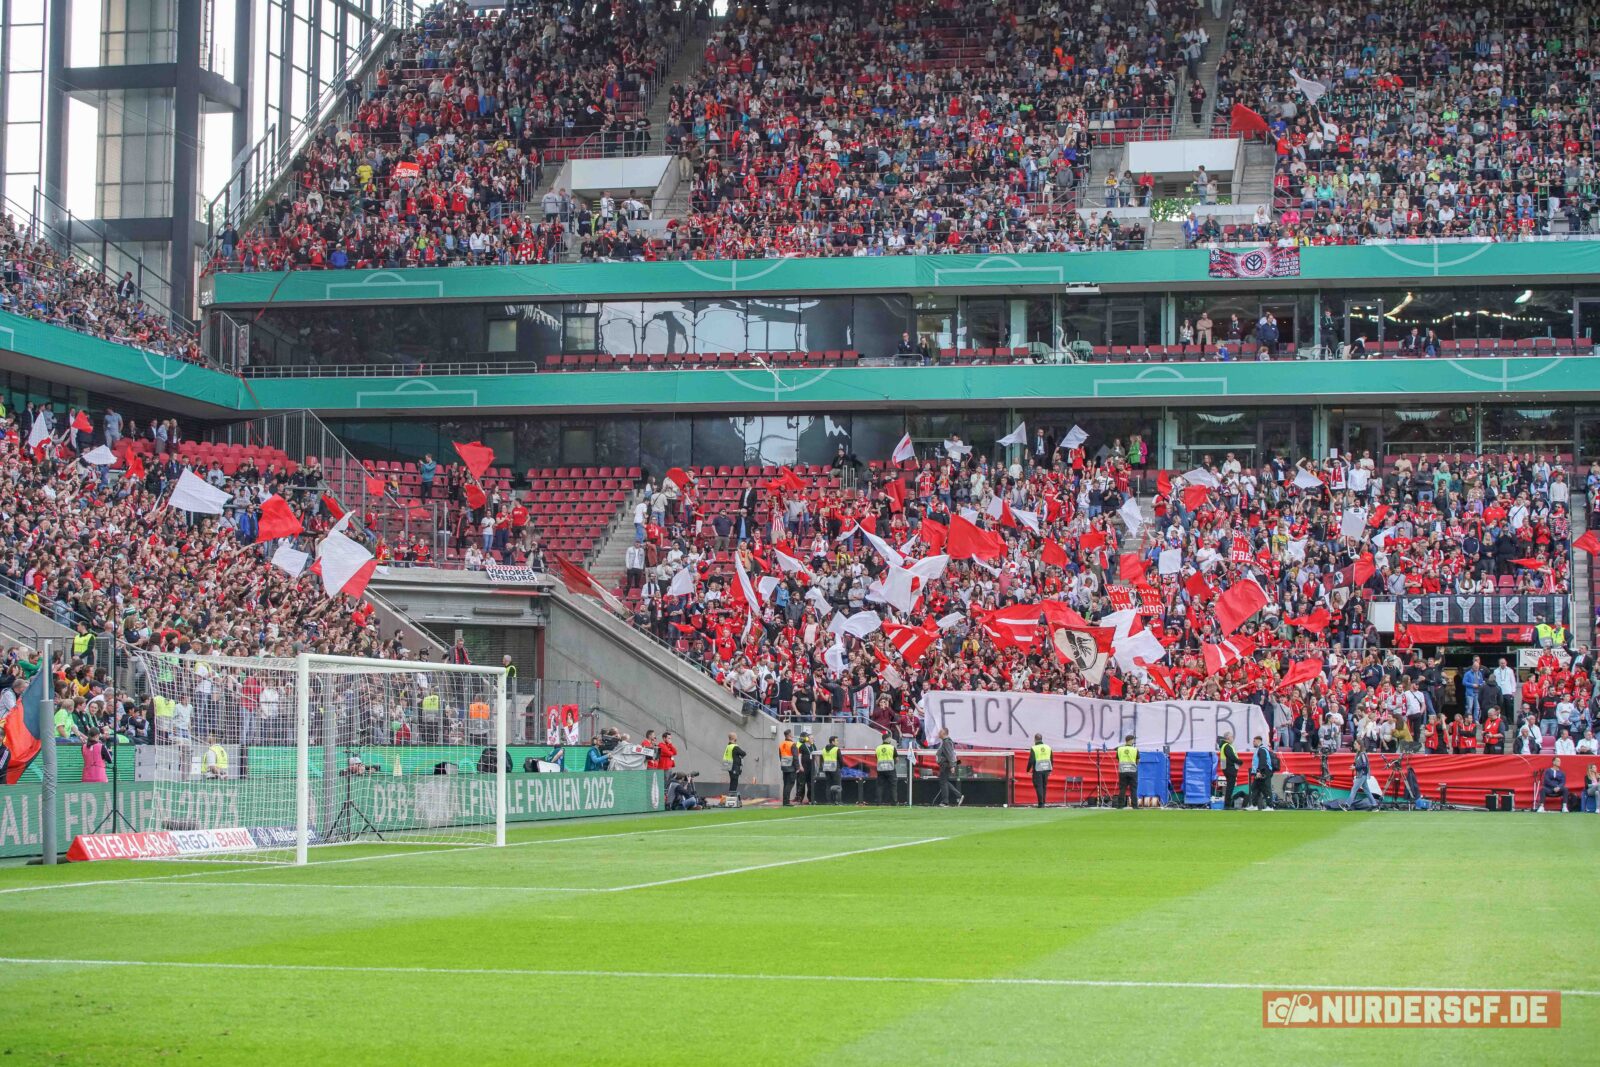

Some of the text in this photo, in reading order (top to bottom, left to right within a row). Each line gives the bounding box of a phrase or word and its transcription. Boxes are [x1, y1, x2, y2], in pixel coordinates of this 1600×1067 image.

[487, 568, 533, 576] VIATORES
[490, 573, 535, 581] FREIBURG
[939, 697, 1030, 738] FICK
[1062, 700, 1137, 745] DICH
[527, 778, 580, 814] FRAUEN
[583, 776, 614, 810] 2023
[65, 788, 172, 841] FRAUEN
[82, 833, 178, 858] FLYERALARM
